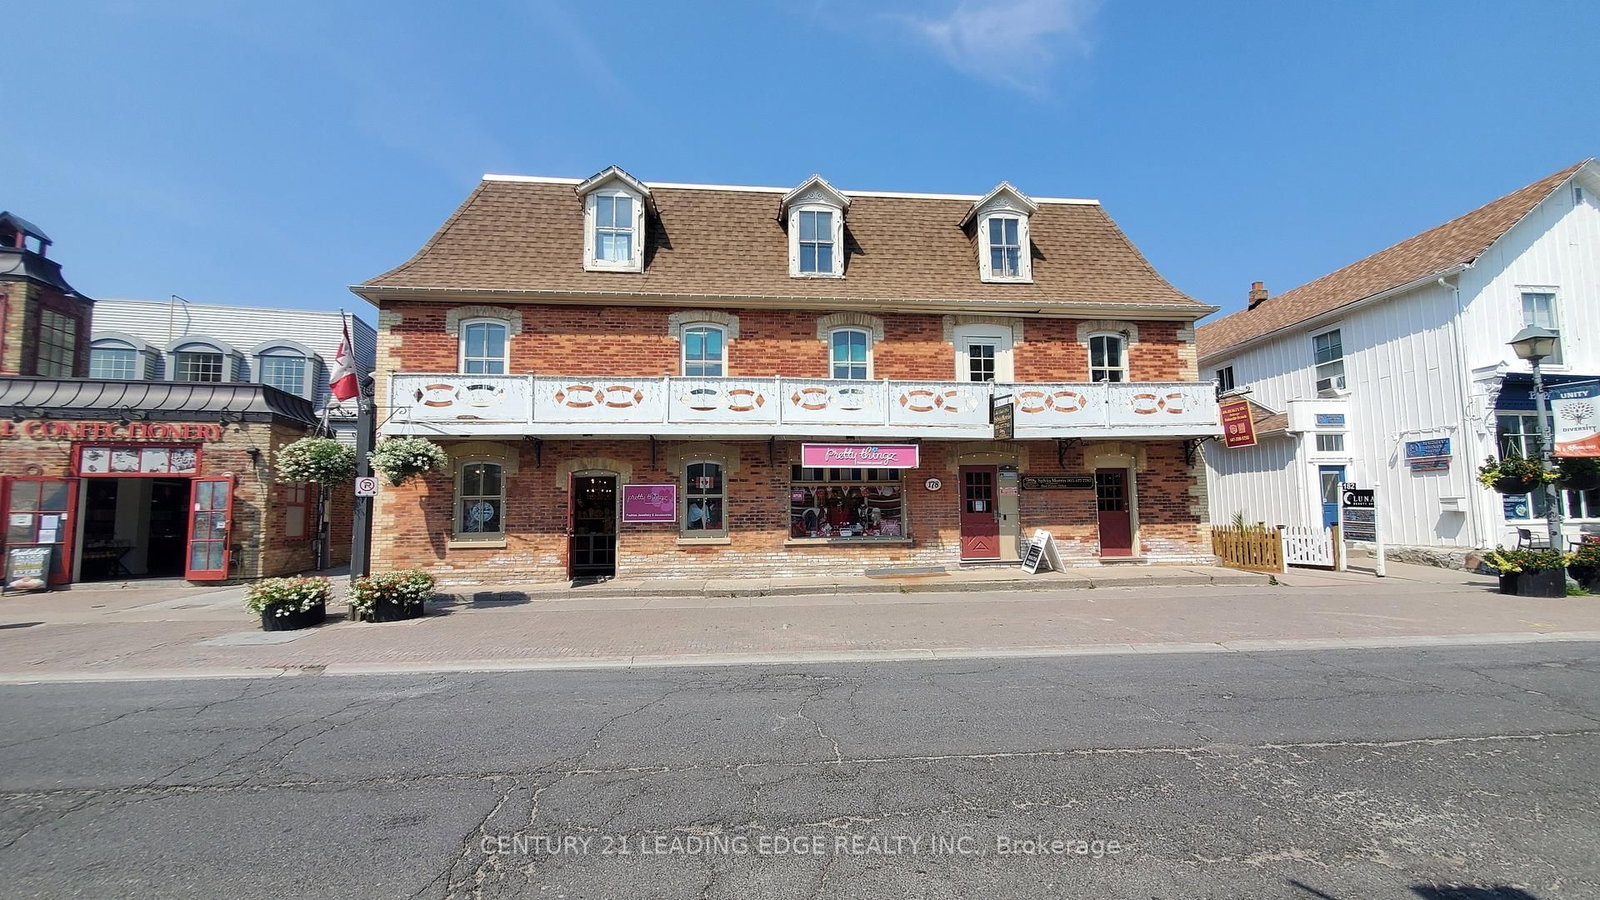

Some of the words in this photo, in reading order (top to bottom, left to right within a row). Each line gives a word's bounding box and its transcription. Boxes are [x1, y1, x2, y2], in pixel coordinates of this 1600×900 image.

[1560, 390, 1589, 399] UNITY
[24, 420, 221, 441] CONFECTIONERY
[825, 447, 857, 465] pretty
[859, 446, 899, 466] thingz
[927, 480, 940, 489] 178
[1343, 482, 1355, 490] 182
